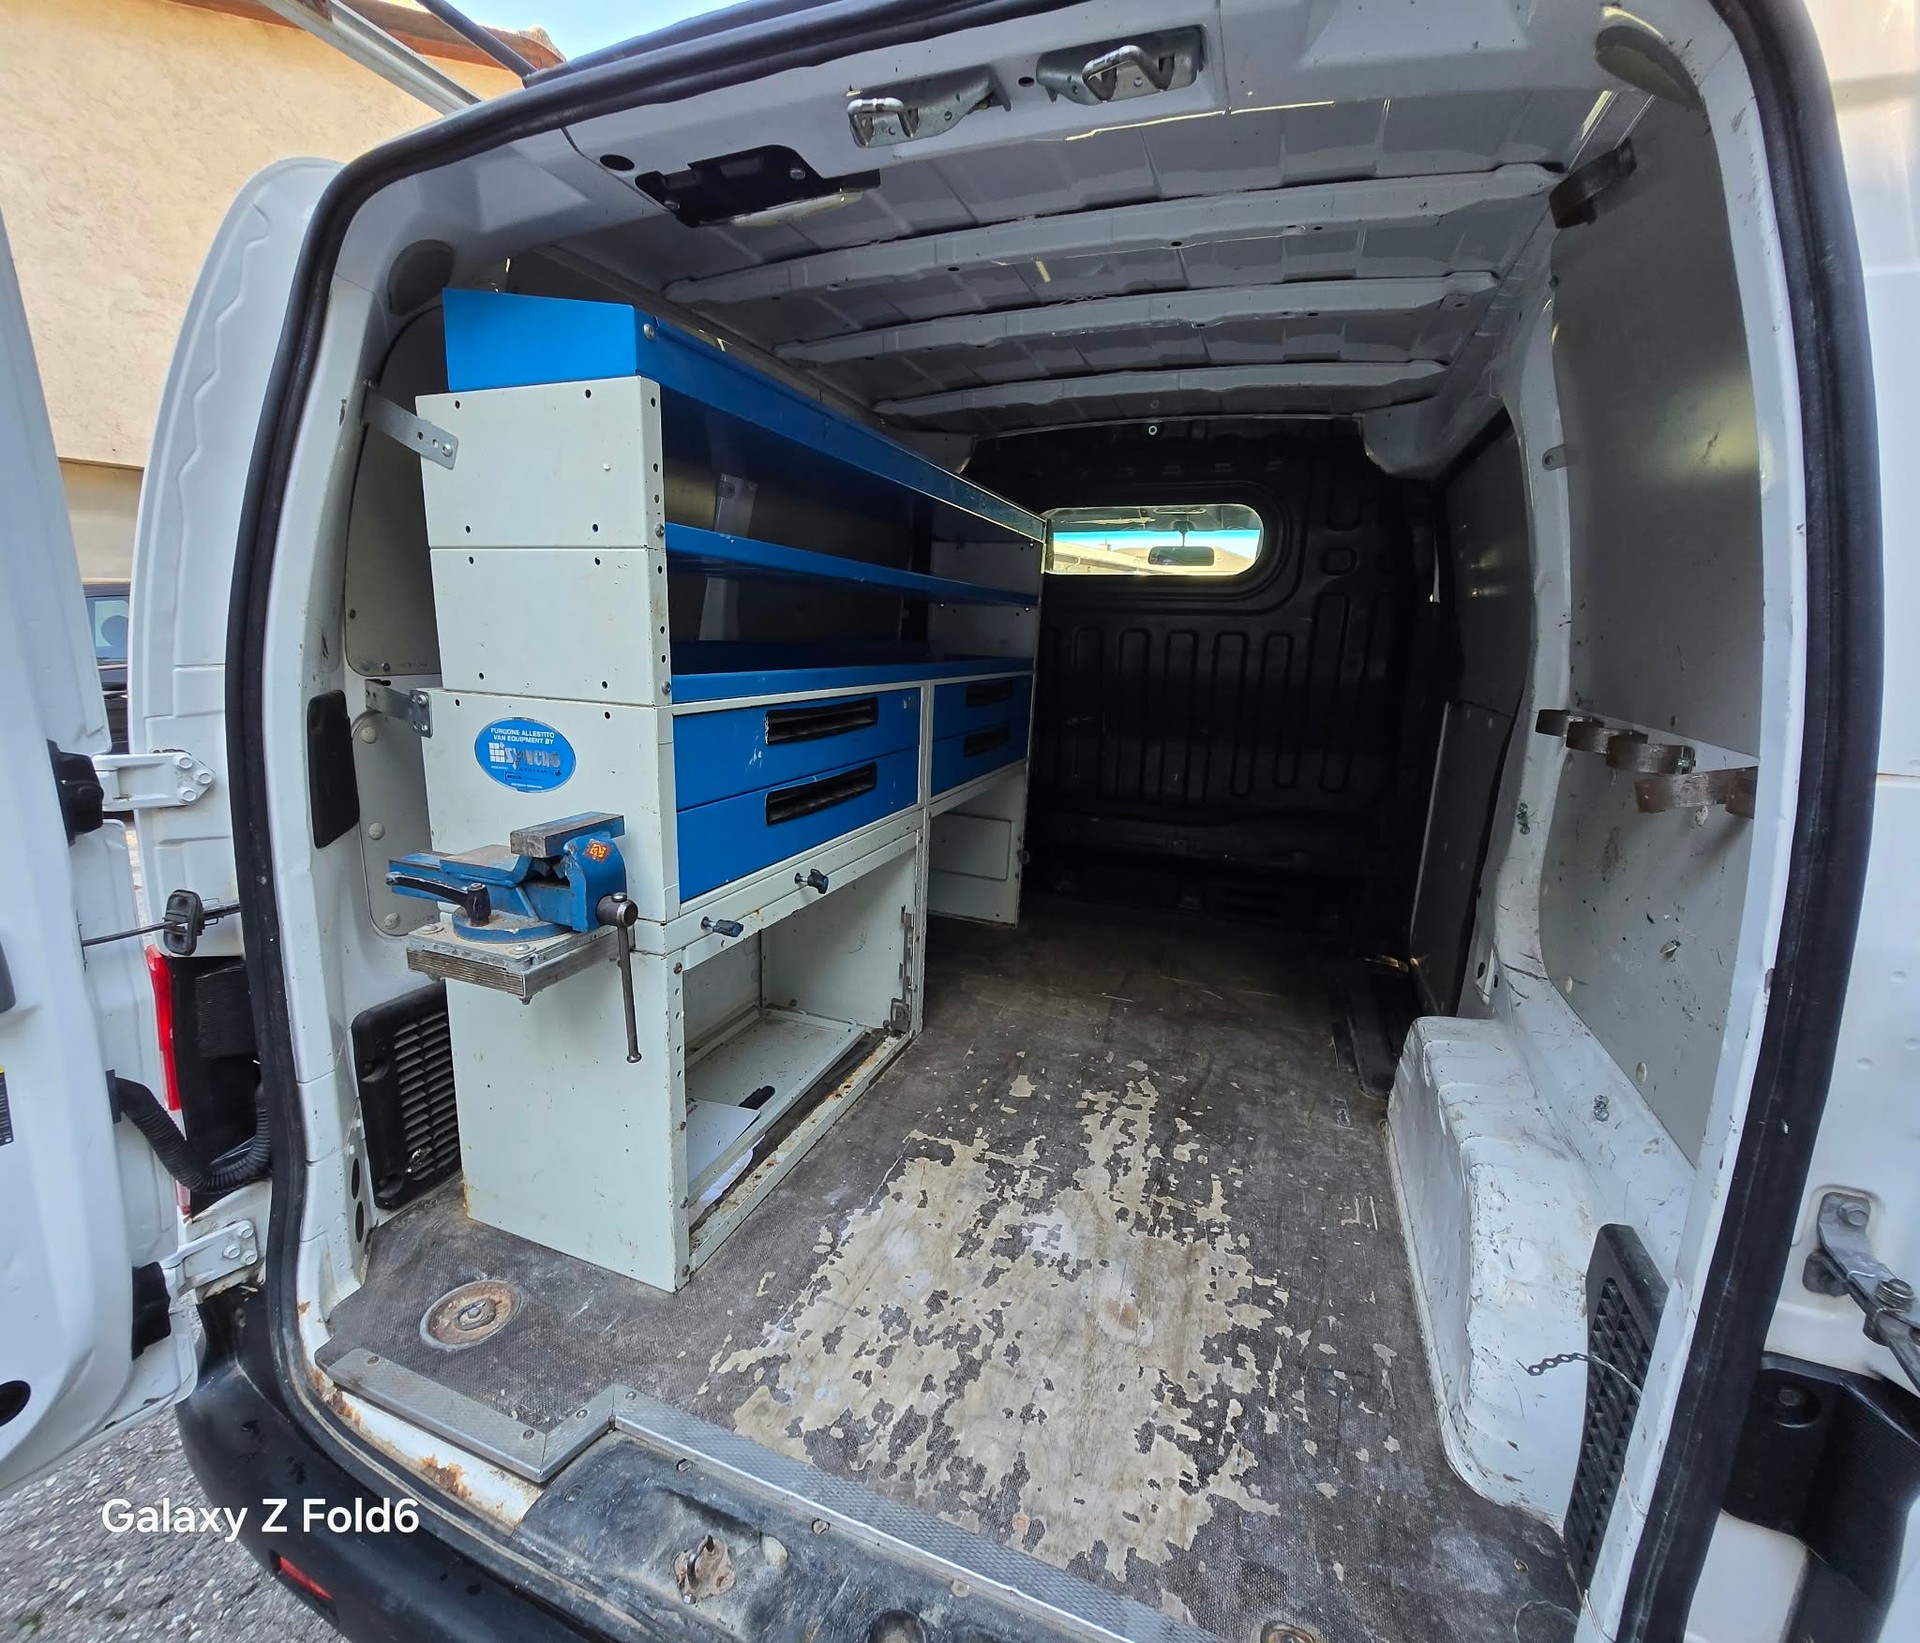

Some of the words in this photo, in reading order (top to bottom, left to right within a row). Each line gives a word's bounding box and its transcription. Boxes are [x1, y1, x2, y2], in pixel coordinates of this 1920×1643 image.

[490, 727, 520, 736] FURGONE
[521, 730, 555, 739] ALLESTITO
[507, 736, 544, 744] EQUIPMENT
